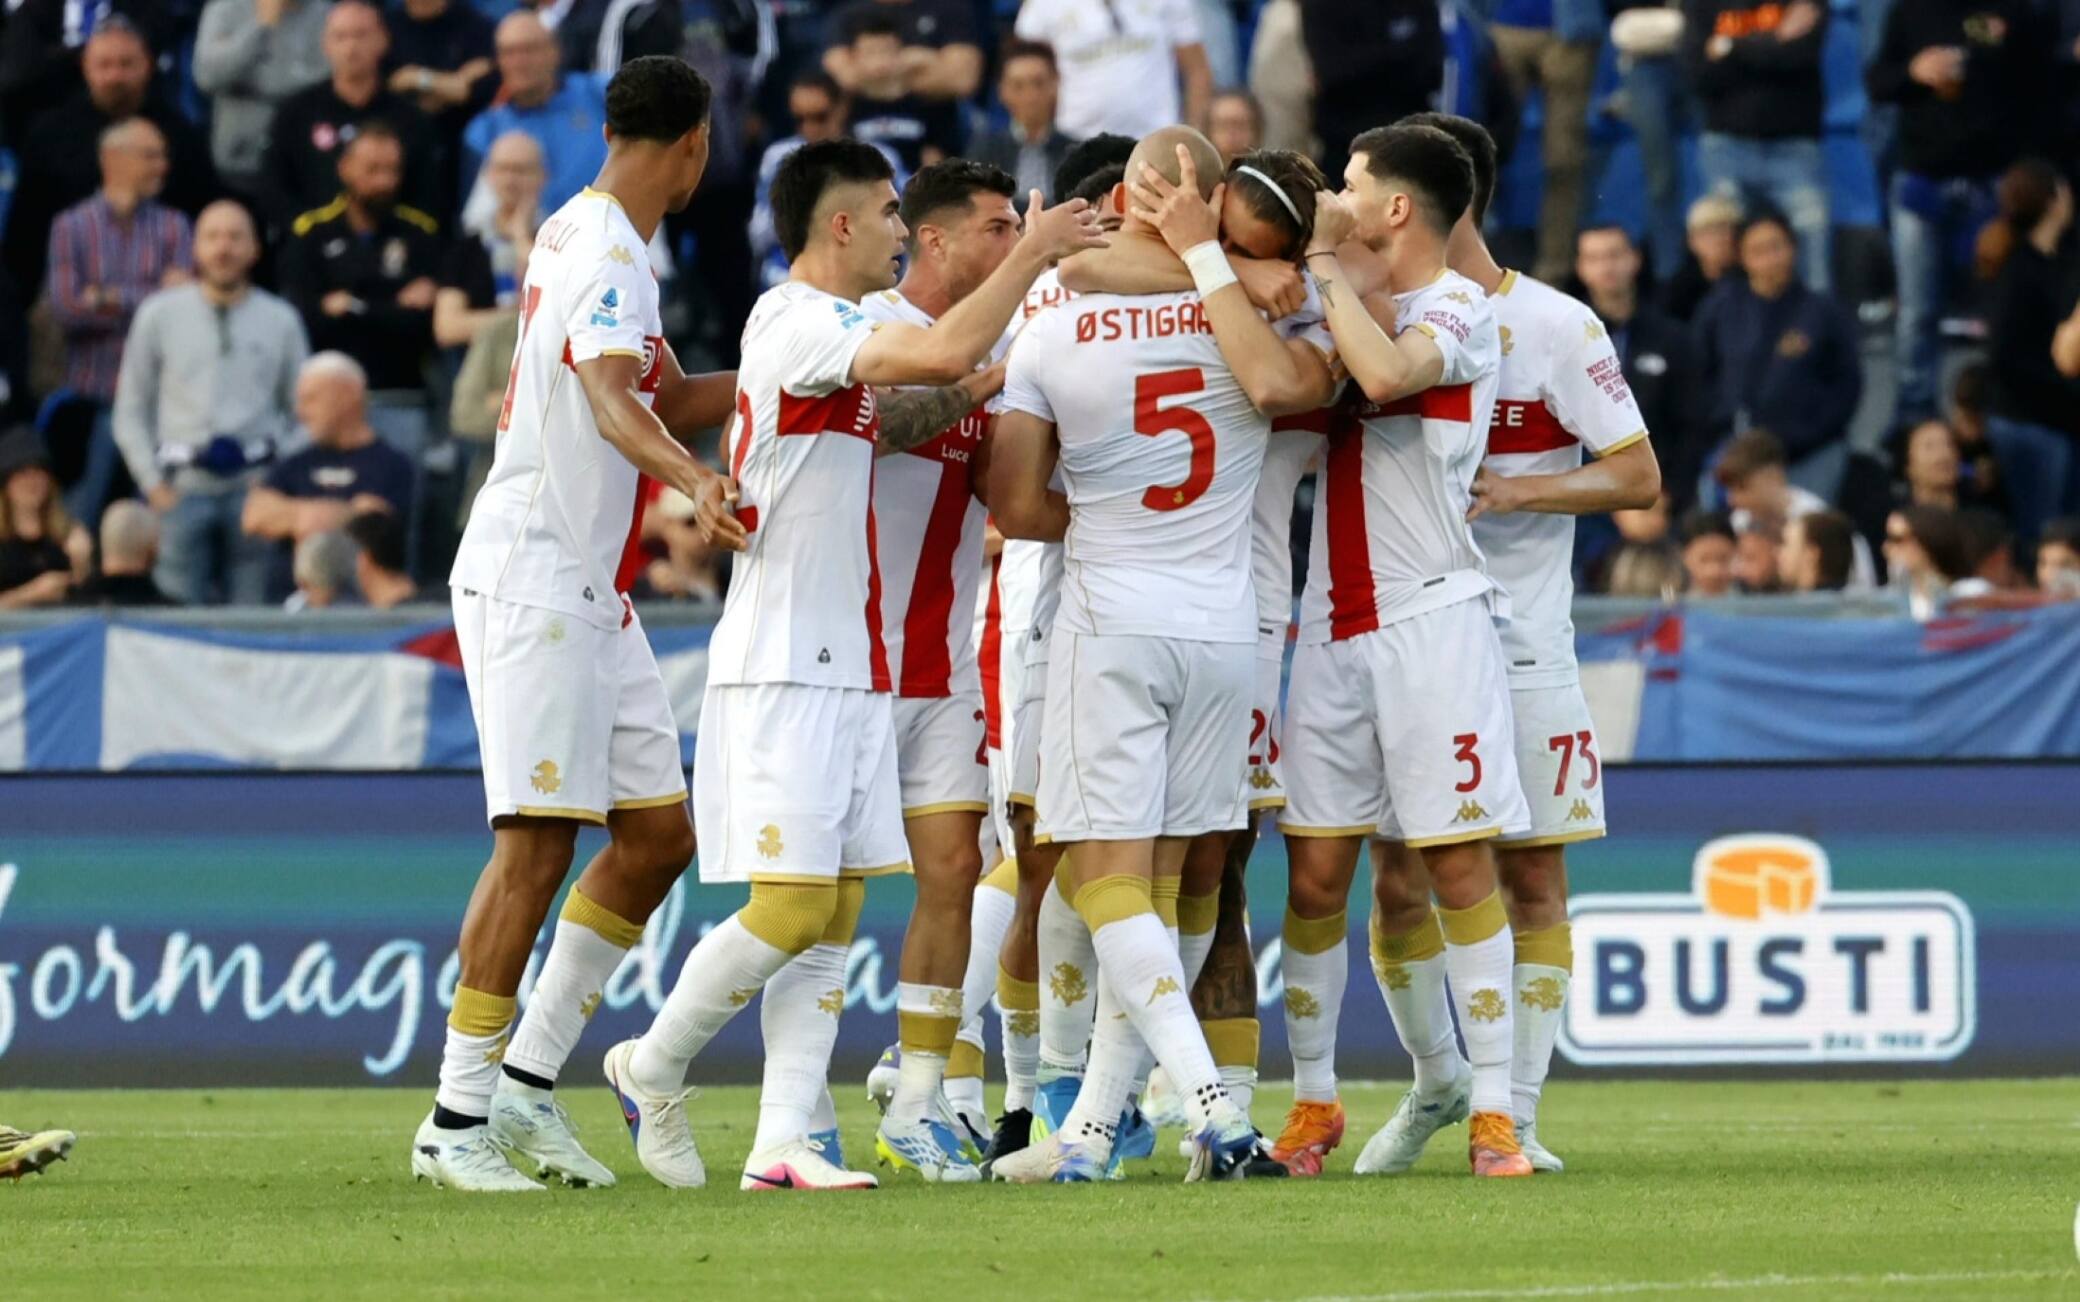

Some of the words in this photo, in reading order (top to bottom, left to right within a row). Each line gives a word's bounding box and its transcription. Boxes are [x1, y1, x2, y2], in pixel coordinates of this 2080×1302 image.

[1075, 295, 1214, 344] ØSTIGÅR
[941, 443, 969, 464] Luce
[1133, 368, 1216, 512] 5
[1453, 732, 1482, 793] 3
[1548, 730, 1598, 796] 73
[1595, 936, 1930, 1016] BUSTI
